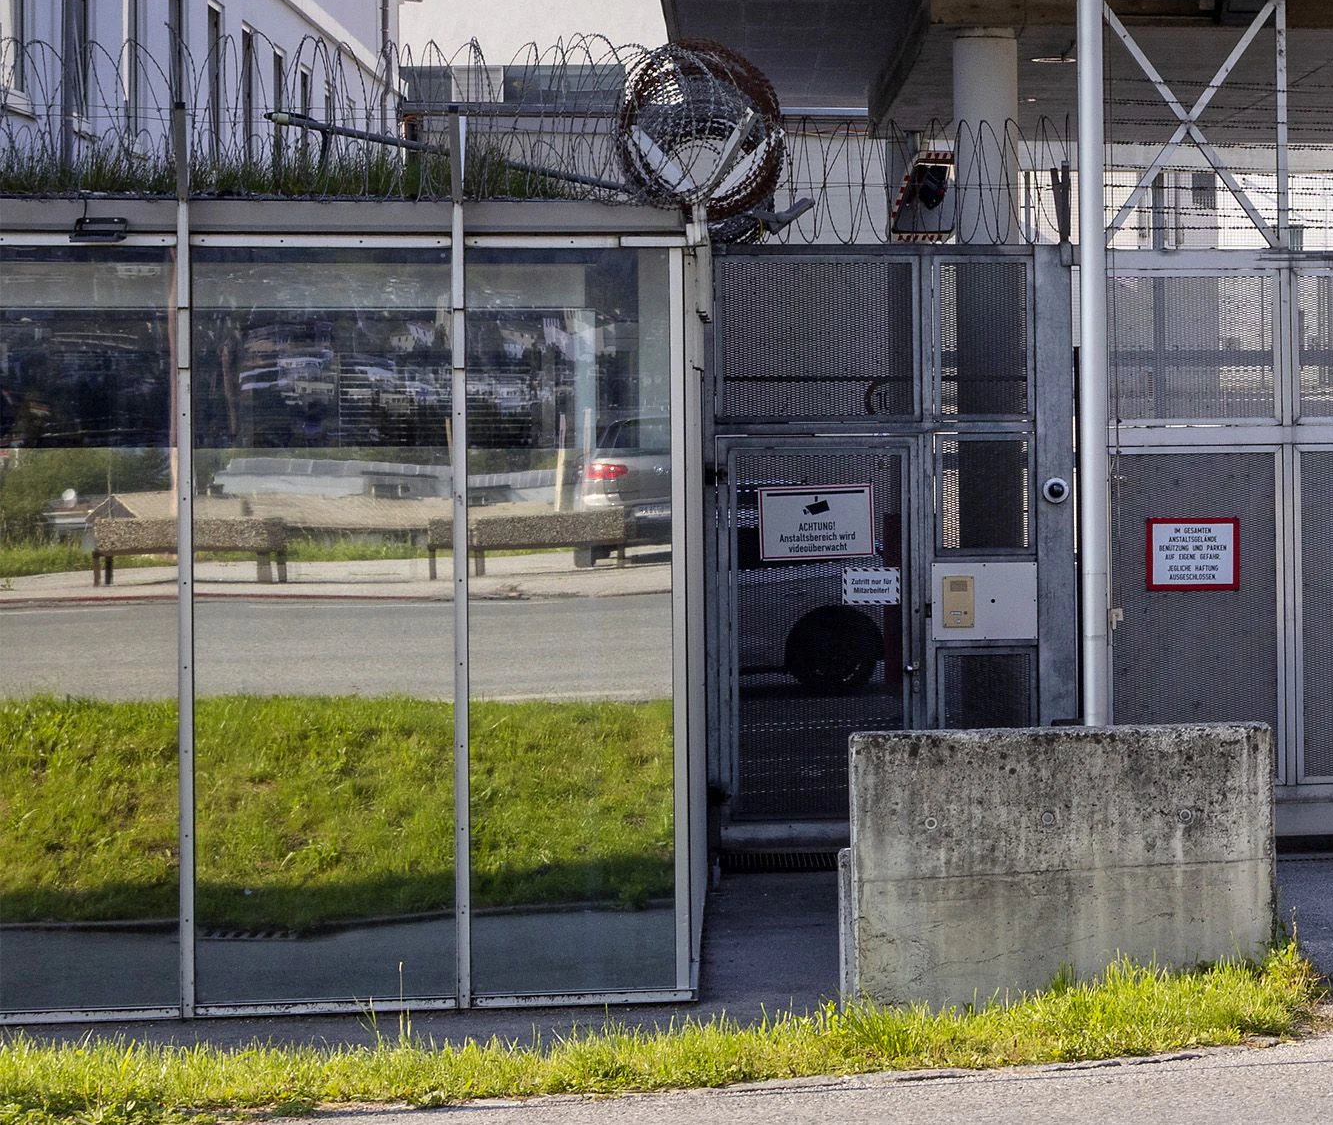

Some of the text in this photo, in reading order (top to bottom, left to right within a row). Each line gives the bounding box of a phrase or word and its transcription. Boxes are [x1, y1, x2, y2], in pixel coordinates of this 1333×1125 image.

[799, 522, 835, 531] ACHTUNG!
[780, 532, 855, 542] Anstaltsbereich wird
[789, 543, 847, 553] videoüberwacht
